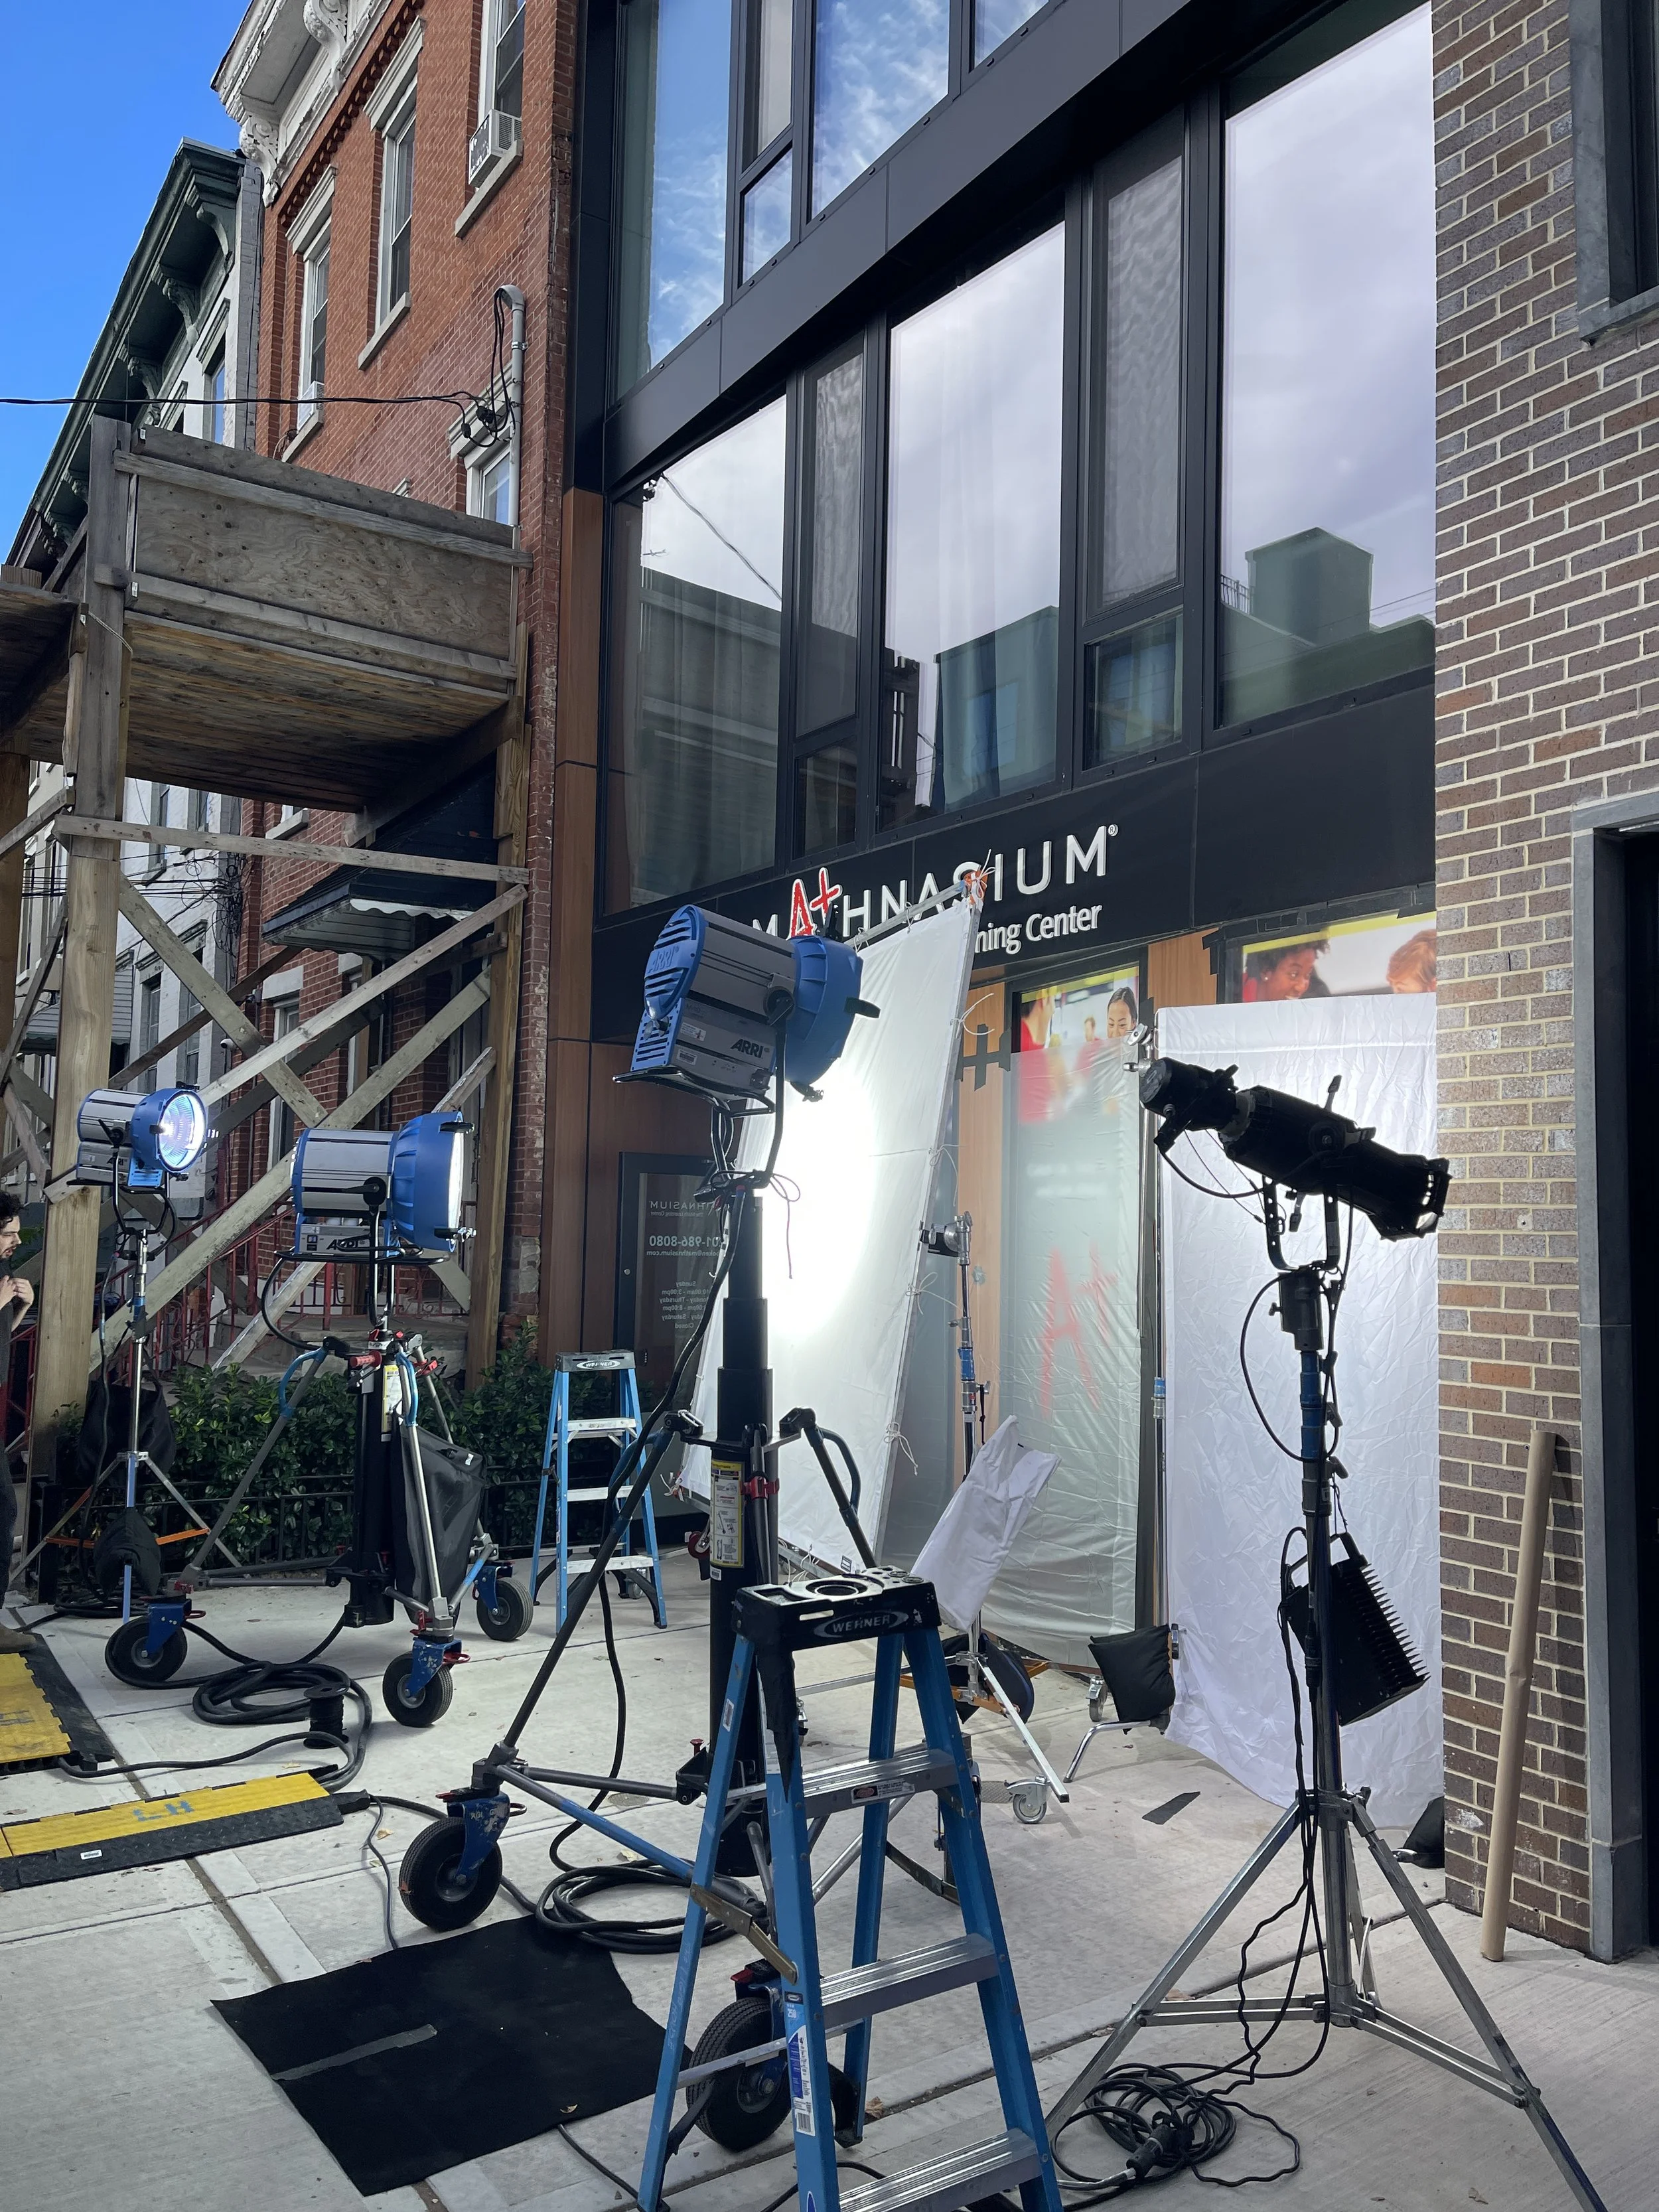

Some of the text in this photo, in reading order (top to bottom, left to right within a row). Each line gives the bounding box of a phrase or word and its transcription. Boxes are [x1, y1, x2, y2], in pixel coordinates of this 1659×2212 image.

[1026, 904, 1103, 942] Center
[730, 1039, 764, 1059] ARRI
[106, 1157, 124, 1166] ARI
